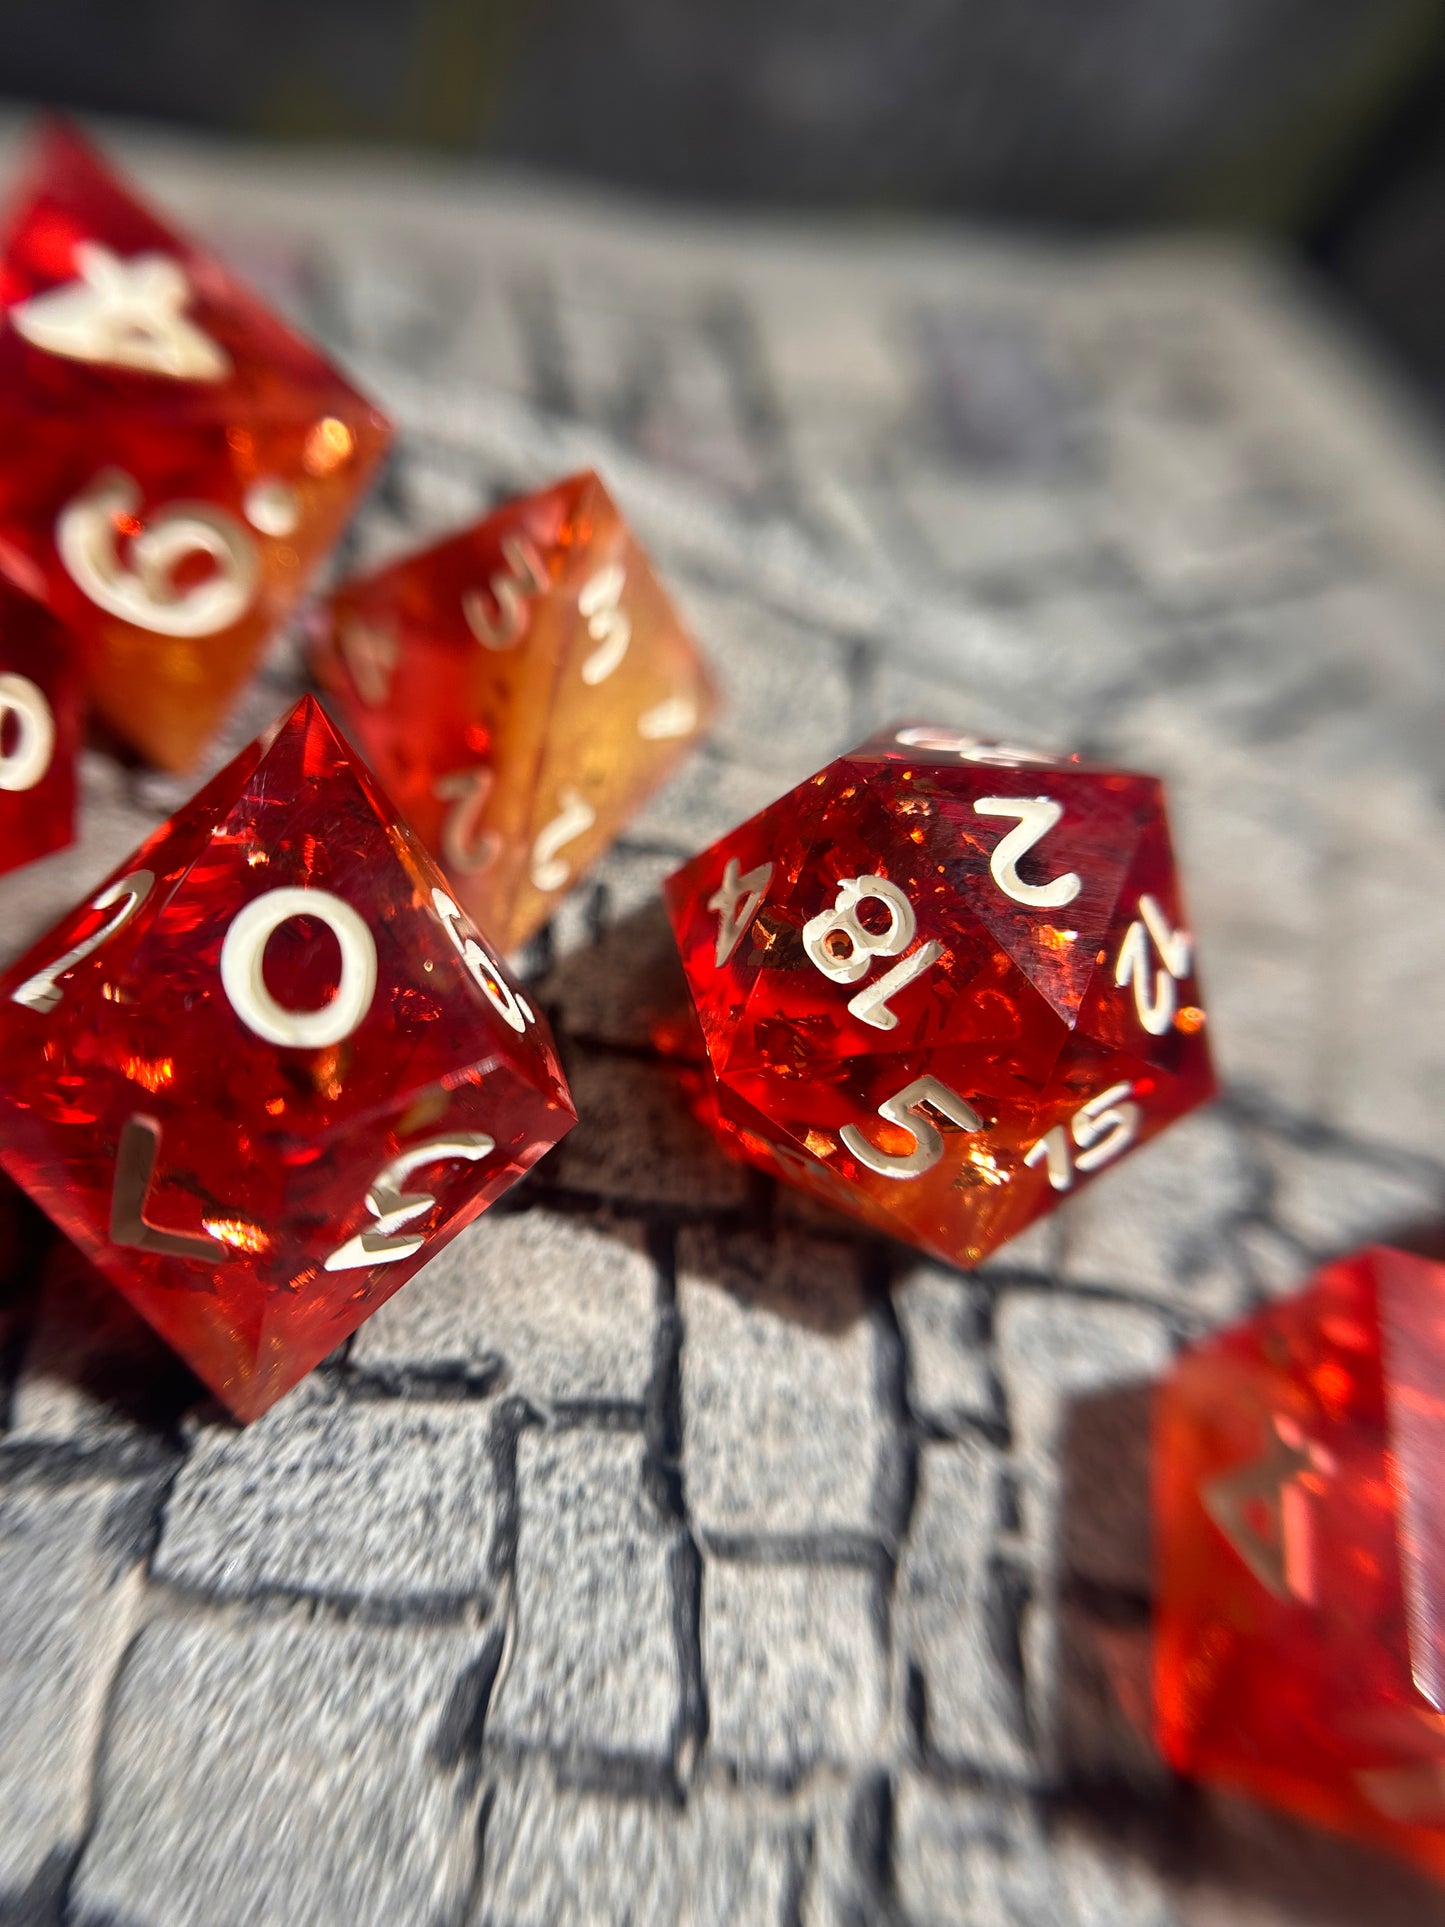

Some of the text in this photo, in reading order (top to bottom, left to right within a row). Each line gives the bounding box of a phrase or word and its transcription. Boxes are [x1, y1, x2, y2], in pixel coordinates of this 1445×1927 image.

[10, 240, 234, 382] 4
[973, 796, 1081, 907] 2
[219, 886, 378, 1050] 0
[708, 857, 774, 968] 4
[802, 874, 945, 1031] 18
[838, 1074, 985, 1180] 5
[1023, 1079, 1143, 1191] 15
